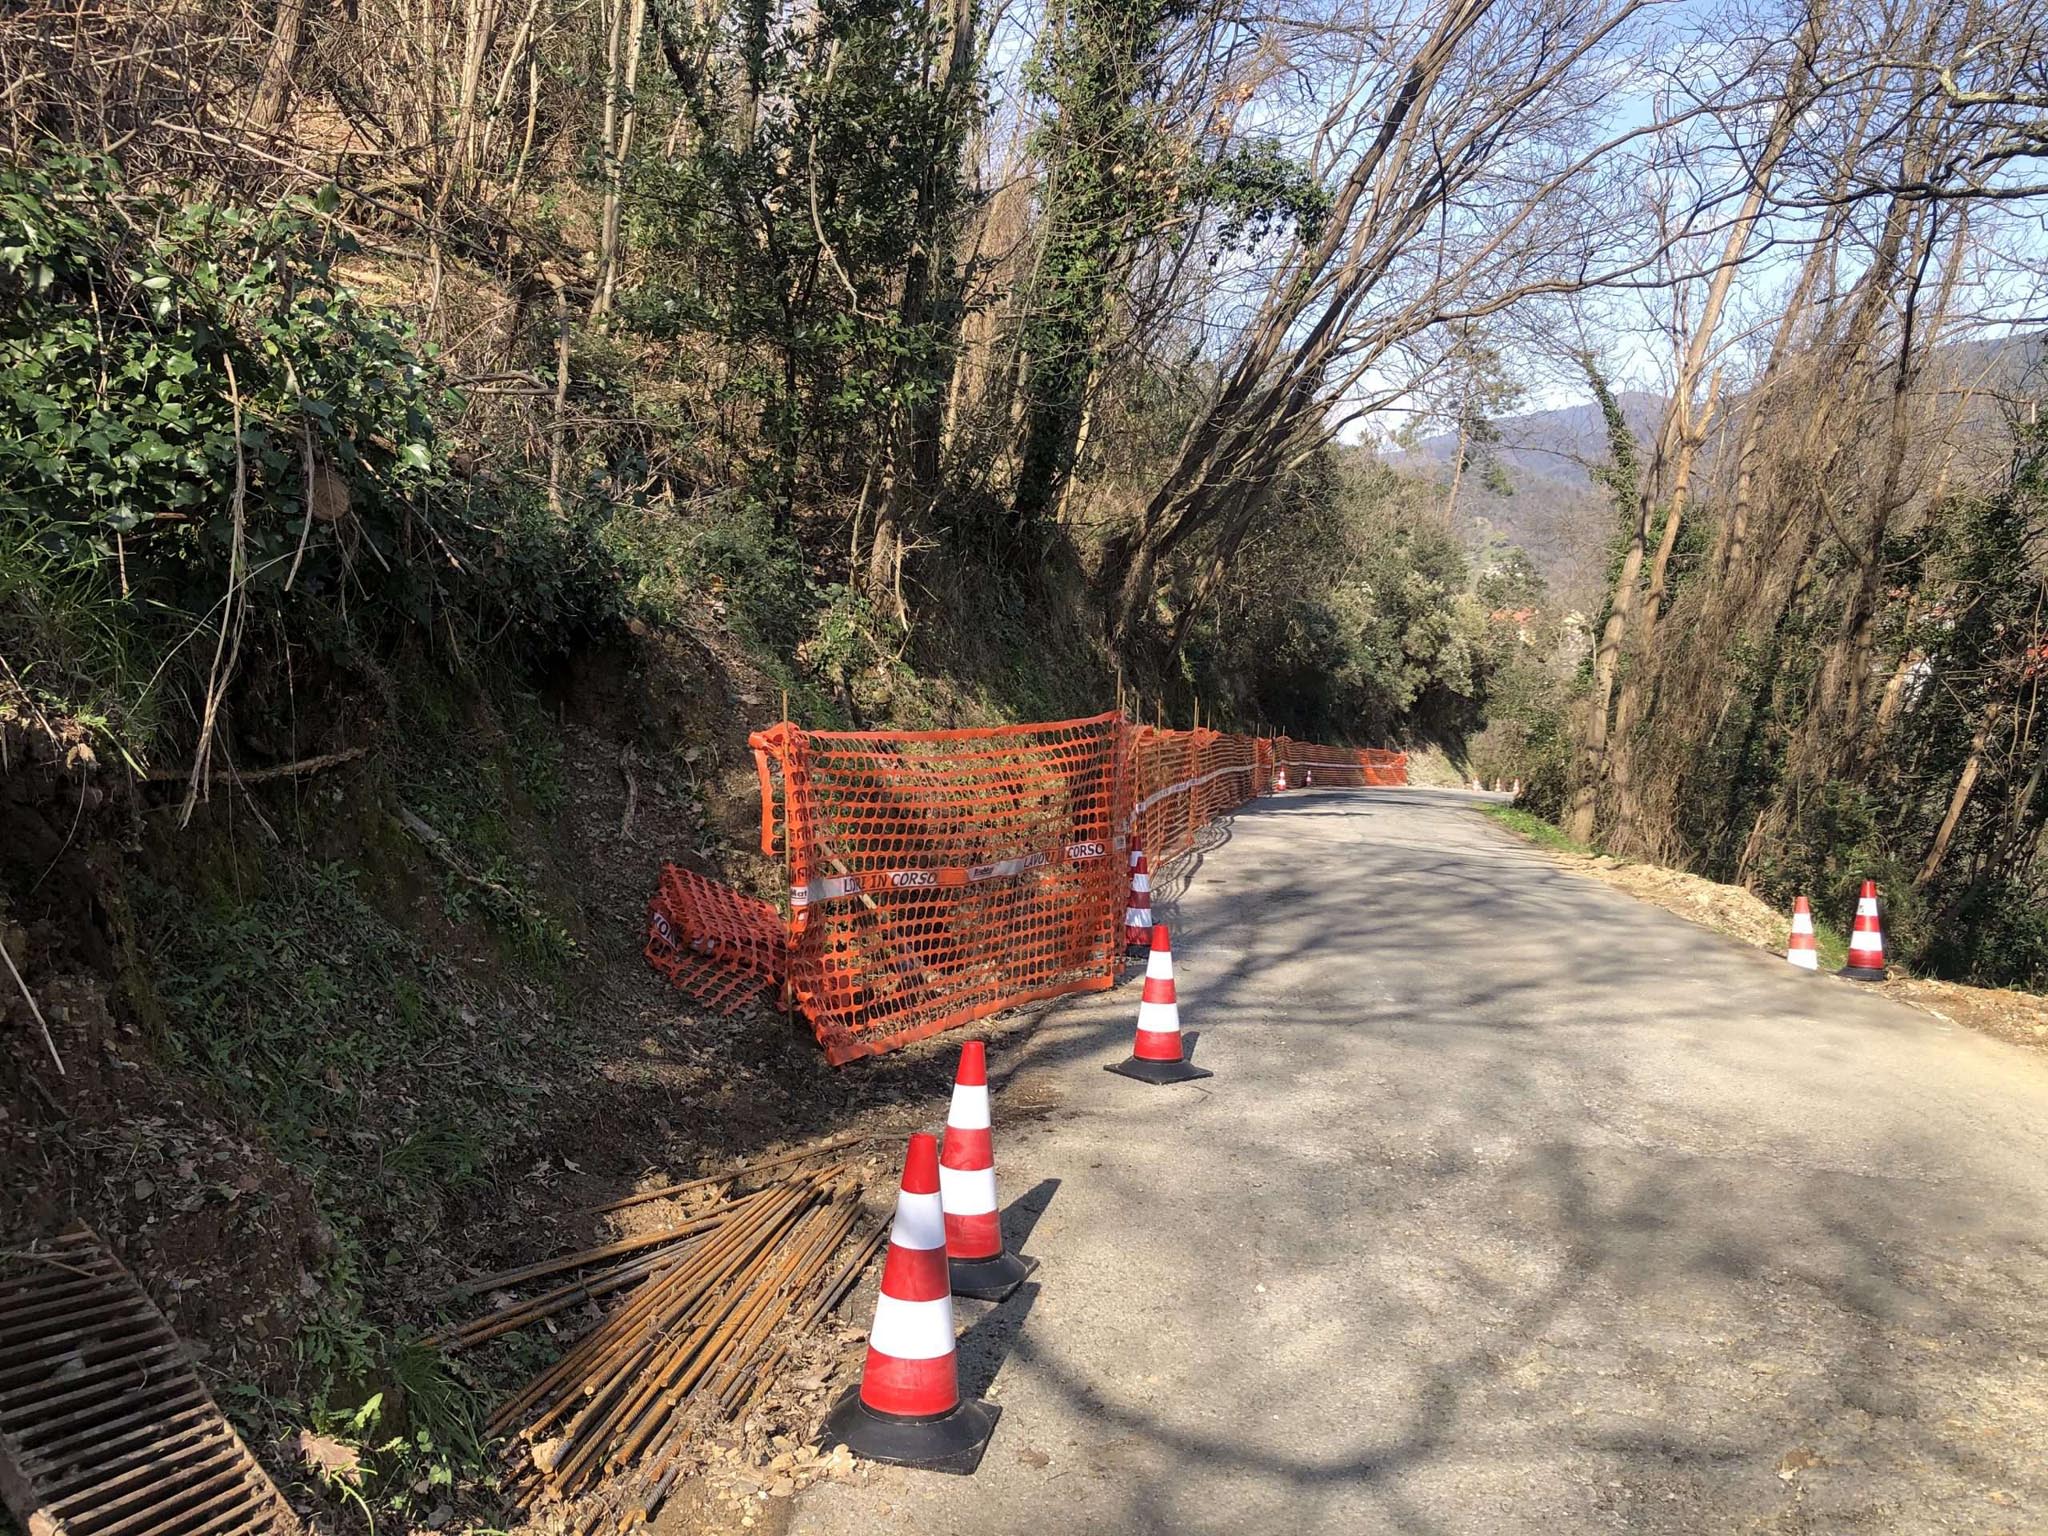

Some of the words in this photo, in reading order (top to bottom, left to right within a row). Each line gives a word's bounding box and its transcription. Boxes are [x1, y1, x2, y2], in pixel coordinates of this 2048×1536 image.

[1023, 851, 1056, 868] LAVORI
[1067, 843, 1106, 858] CORSO
[870, 873, 888, 888] IN
[891, 871, 938, 886] CORSO
